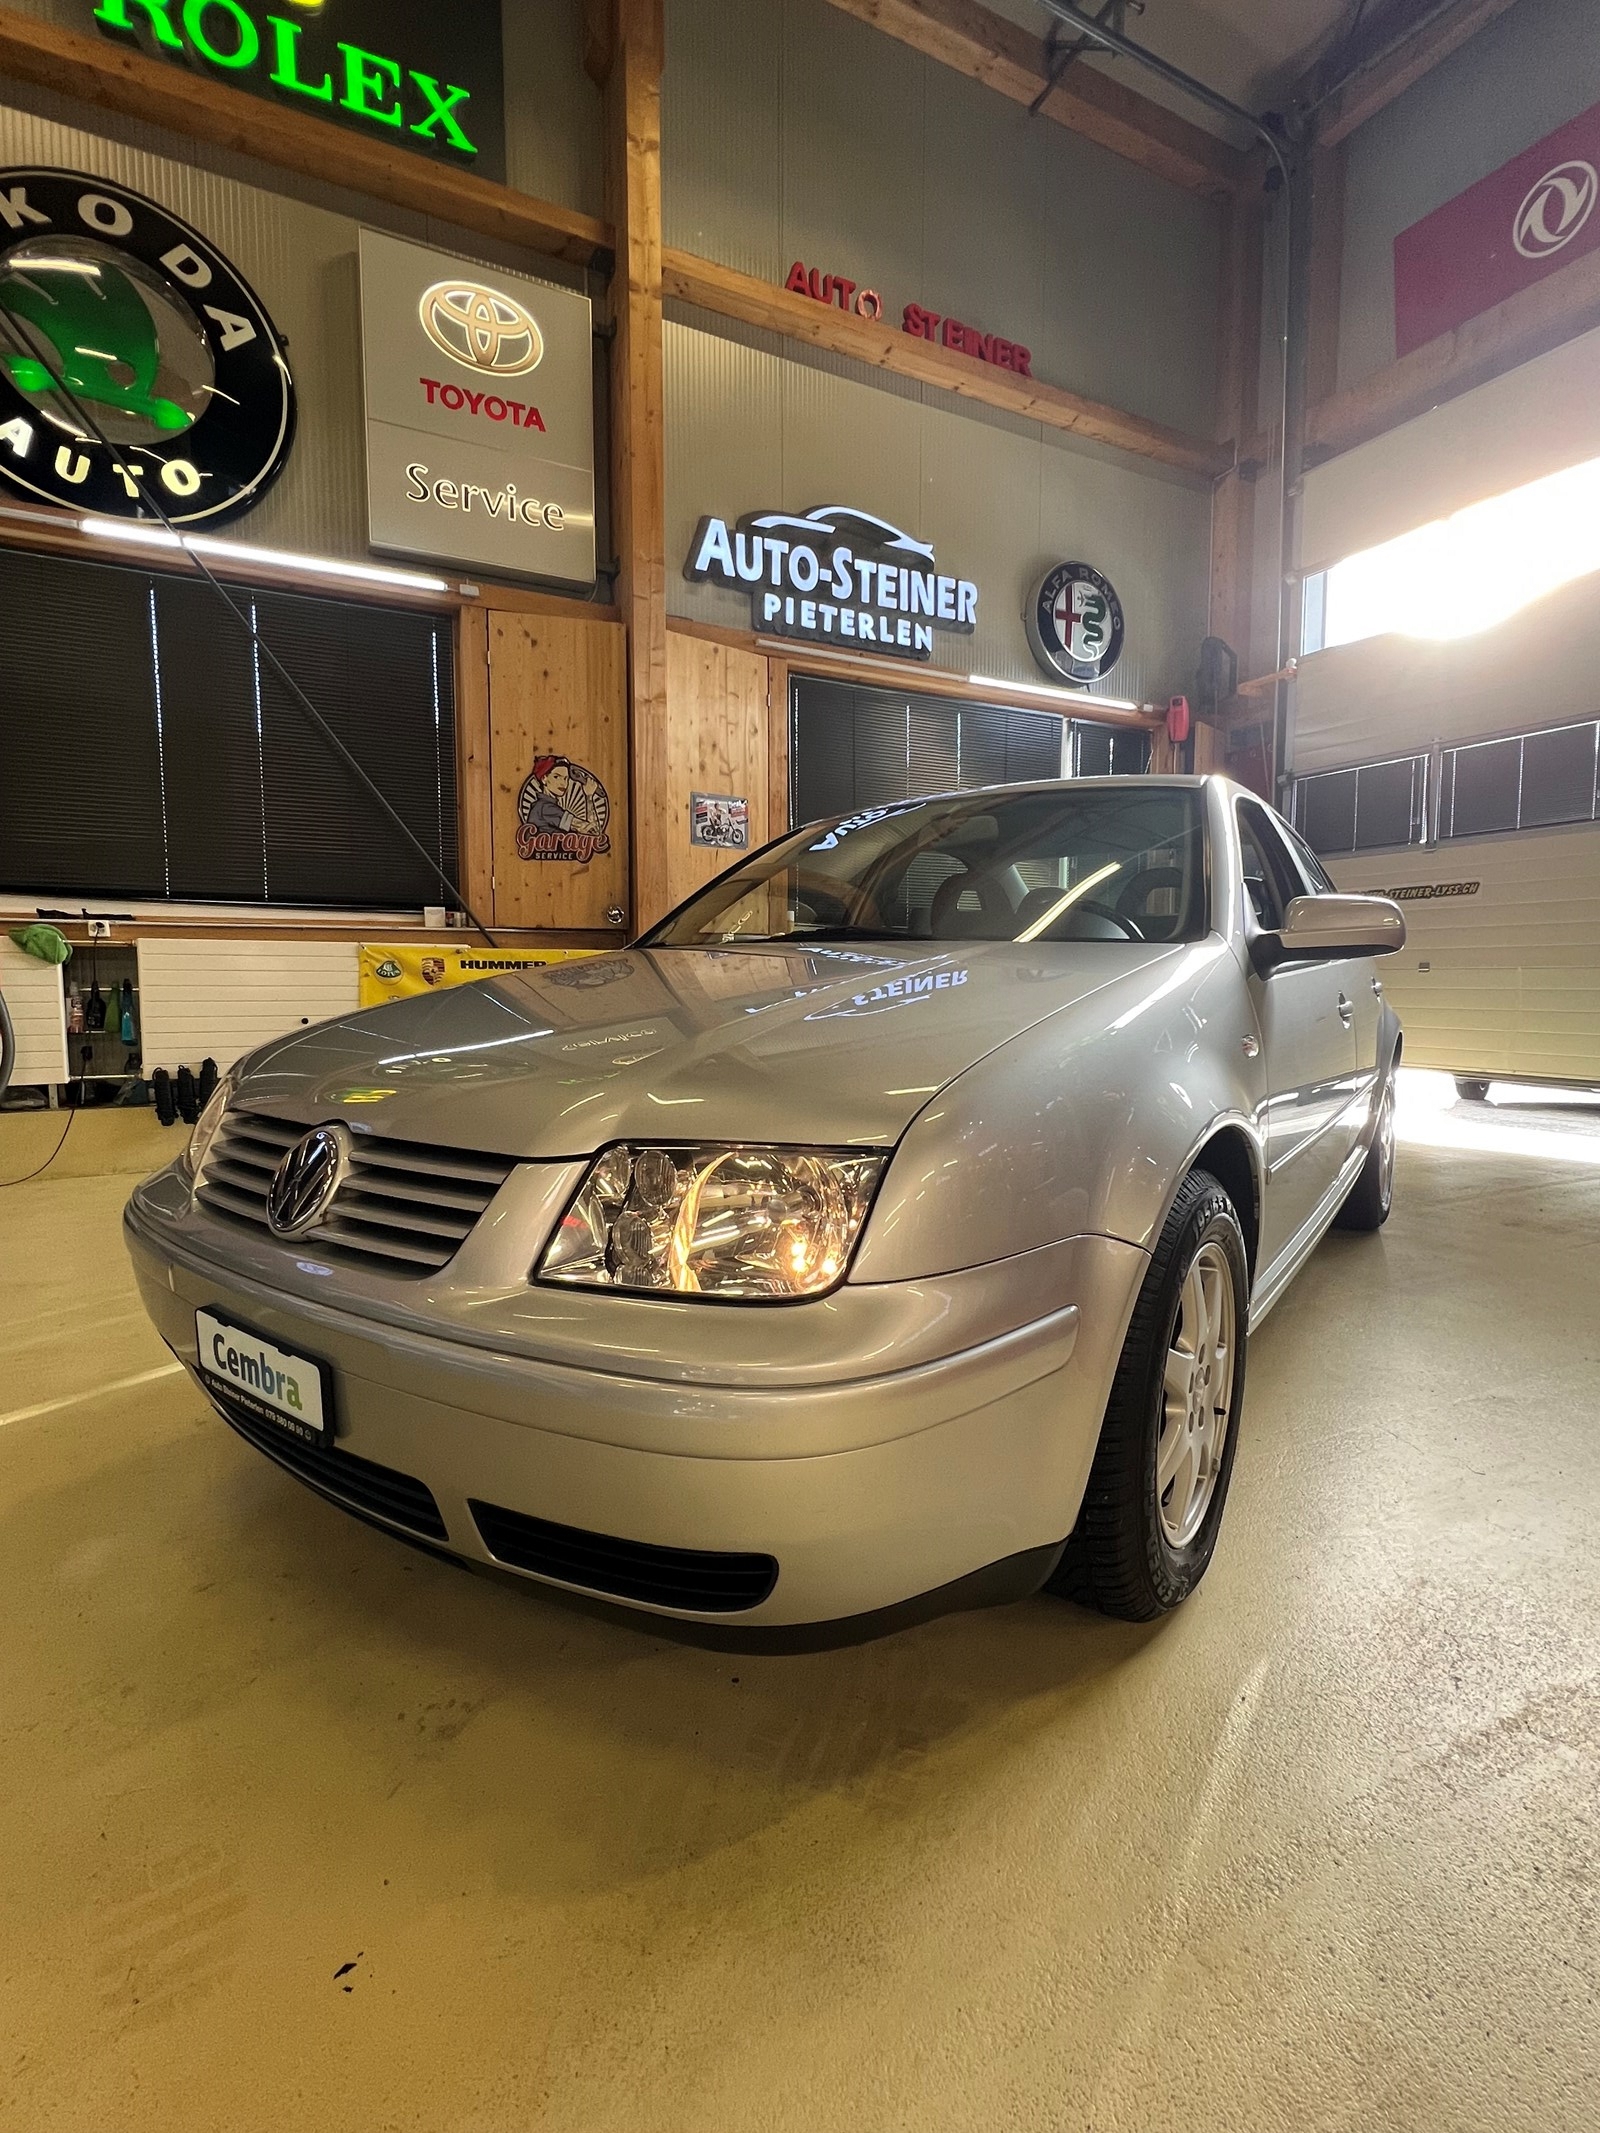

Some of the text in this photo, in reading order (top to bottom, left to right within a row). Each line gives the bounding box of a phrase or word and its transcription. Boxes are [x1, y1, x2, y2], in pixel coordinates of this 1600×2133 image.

[785, 261, 1033, 377] AUTO STEINER
[419, 377, 546, 433] TOYOTA
[0, 417, 201, 498] AUTO
[406, 463, 565, 530] Service
[695, 518, 978, 624] AUTO-STEINER
[1042, 567, 1121, 630] ALFA ROMEO
[764, 592, 933, 651] PIETERLEN
[517, 824, 609, 862] Garage
[536, 852, 573, 860] SERVICE
[213, 1333, 302, 1411] Cembra
